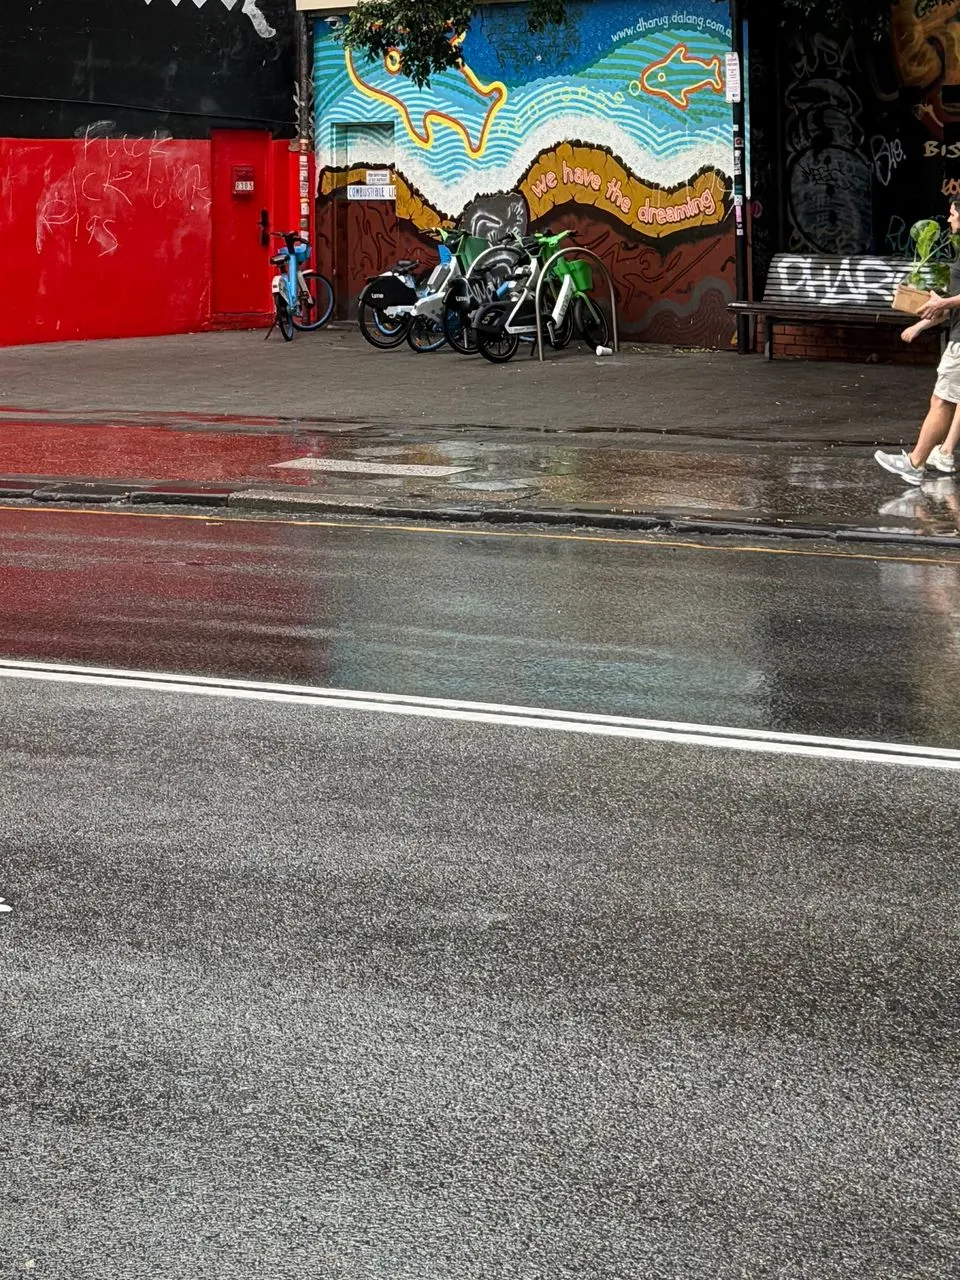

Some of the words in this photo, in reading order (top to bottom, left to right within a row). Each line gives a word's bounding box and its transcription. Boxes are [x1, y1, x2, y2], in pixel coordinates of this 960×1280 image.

[531, 171, 558, 198] we
[562, 160, 602, 191] have
[605, 177, 632, 213] the
[637, 188, 716, 224] dreaming
